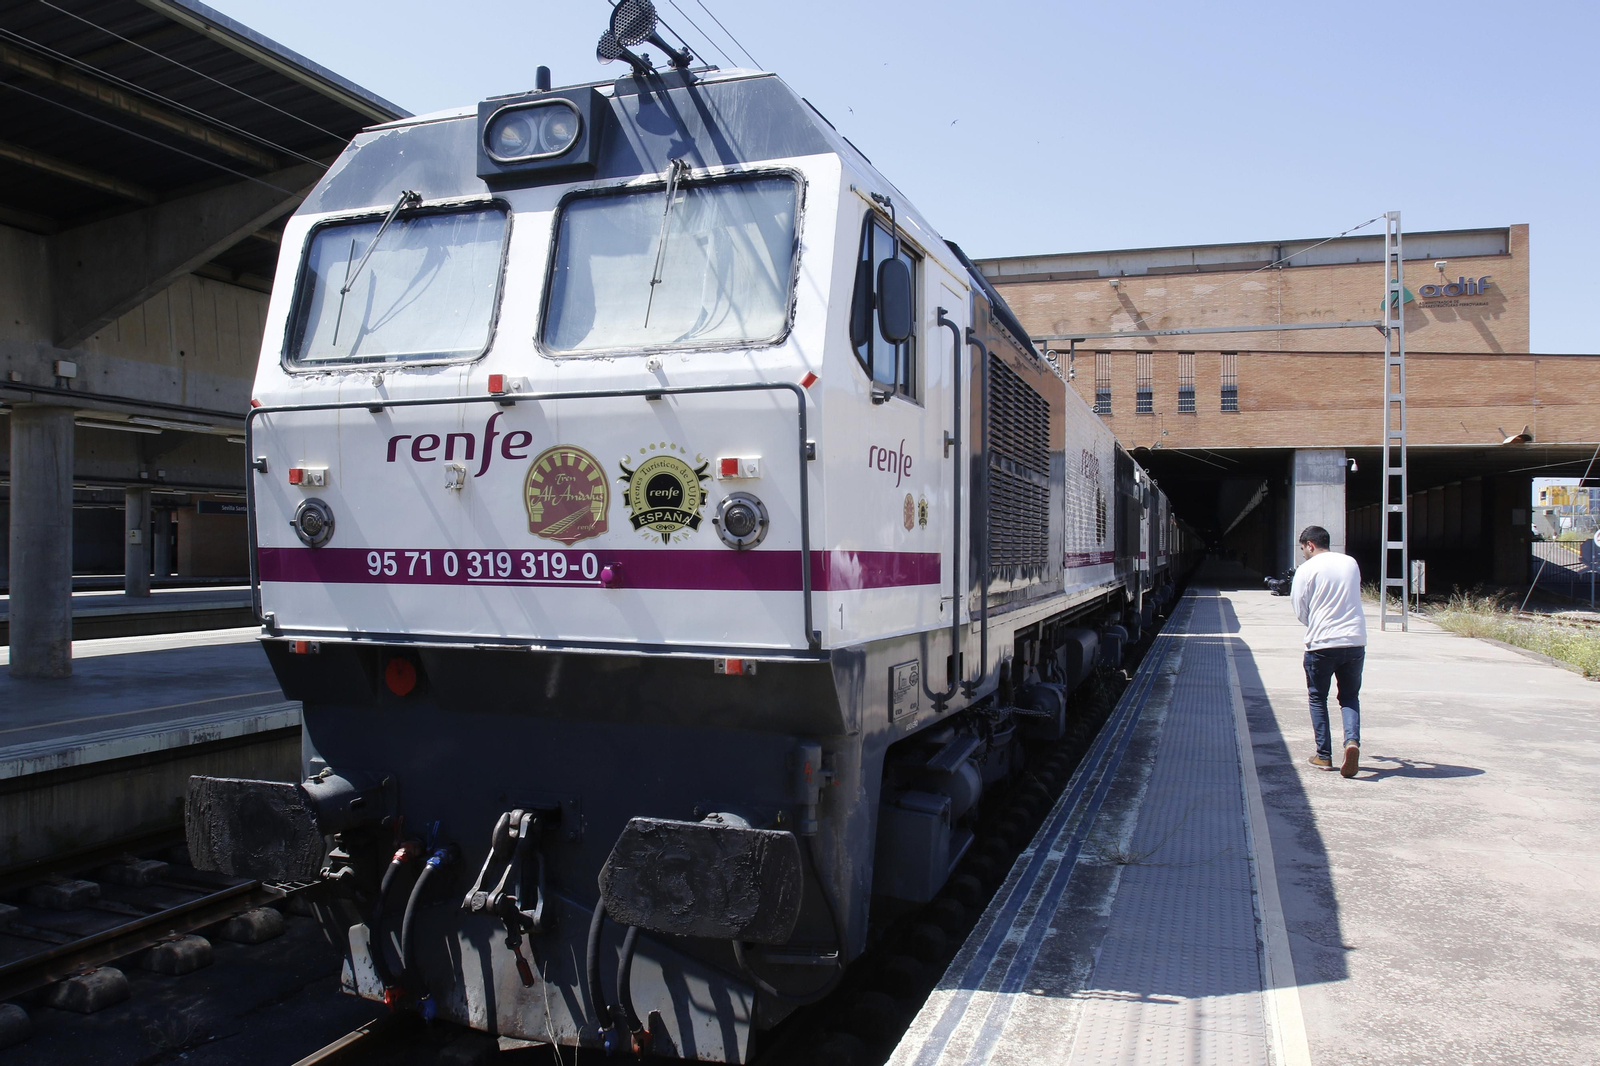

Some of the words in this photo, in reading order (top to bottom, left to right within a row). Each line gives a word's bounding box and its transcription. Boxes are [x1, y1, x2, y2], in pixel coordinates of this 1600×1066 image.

[1418, 275, 1492, 297] adif
[386, 411, 533, 477] renfe
[868, 438, 913, 488] renfe
[555, 473, 576, 485] Tren
[634, 477, 643, 507] Trenes
[640, 460, 680, 476] Turísticos
[679, 469, 689, 479] de
[686, 479, 697, 507] LUJO
[649, 486, 680, 500] renfe
[638, 511, 691, 526] ESPAÑA
[366, 551, 398, 576] 95
[404, 551, 432, 576] 71
[443, 551, 459, 577] 0
[467, 551, 512, 577] 319
[520, 552, 599, 579] 319-0
[838, 603, 844, 630] 1
